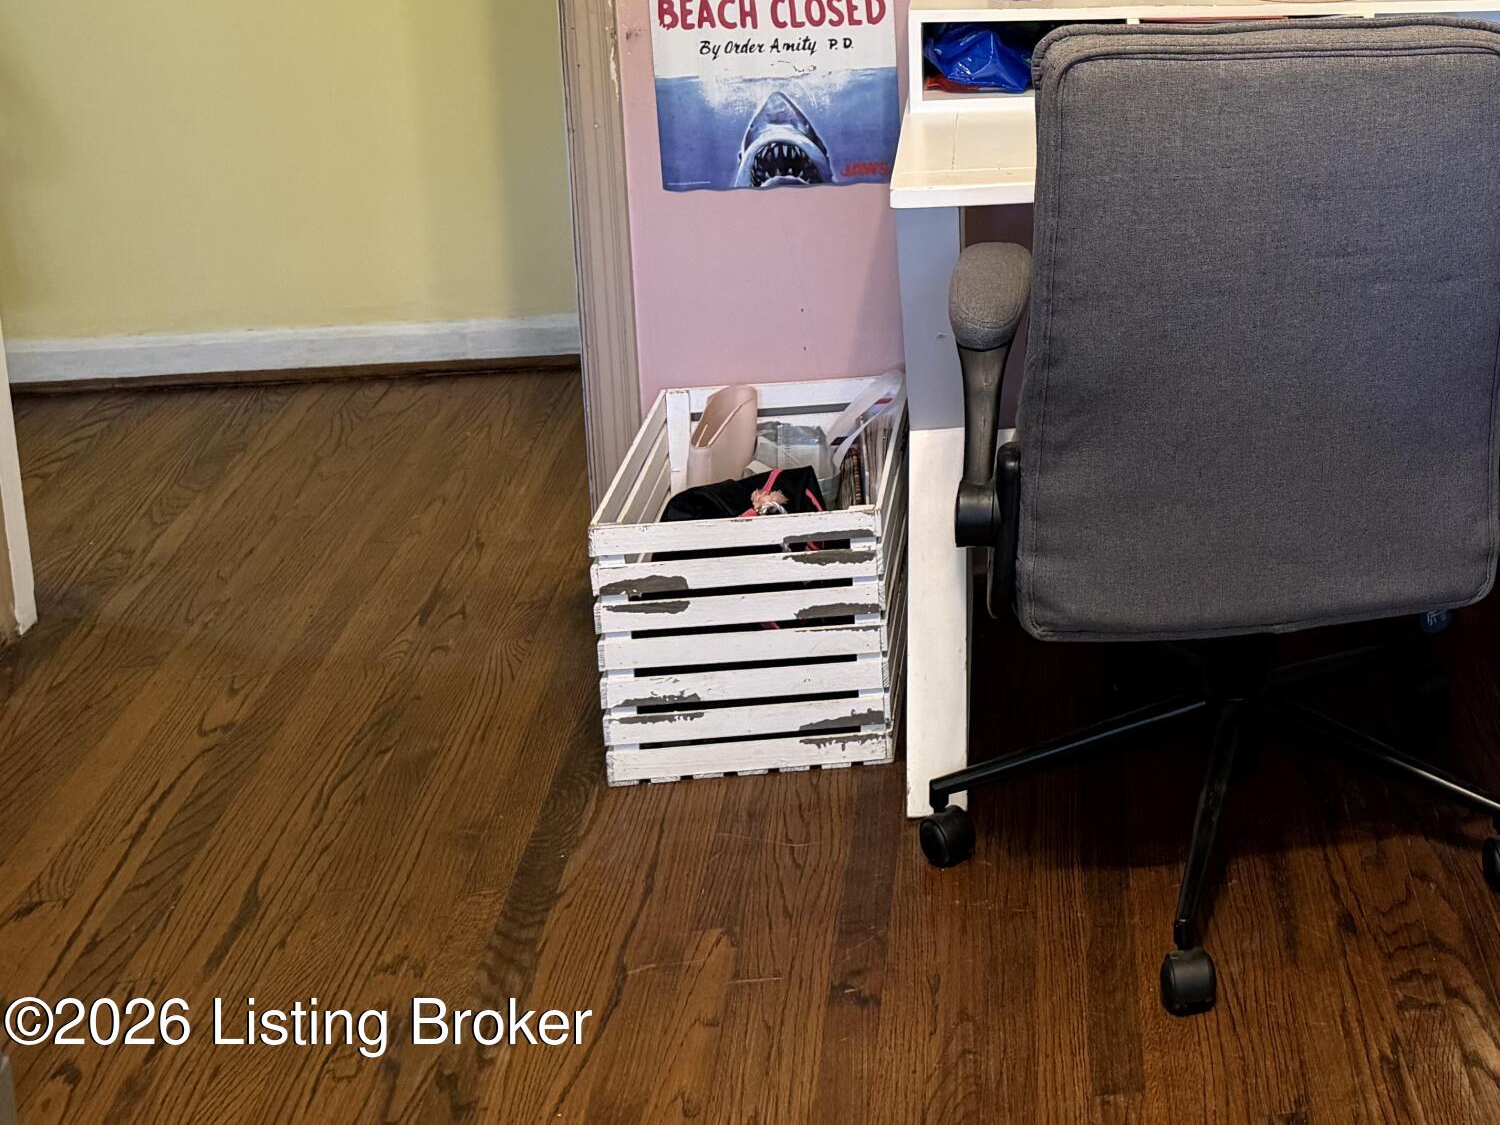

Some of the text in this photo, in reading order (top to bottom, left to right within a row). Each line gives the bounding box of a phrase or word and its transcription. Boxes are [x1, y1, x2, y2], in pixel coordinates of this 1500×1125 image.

[699, 40, 720, 60] By
[724, 38, 764, 54] Order
[770, 36, 817, 55] Amity
